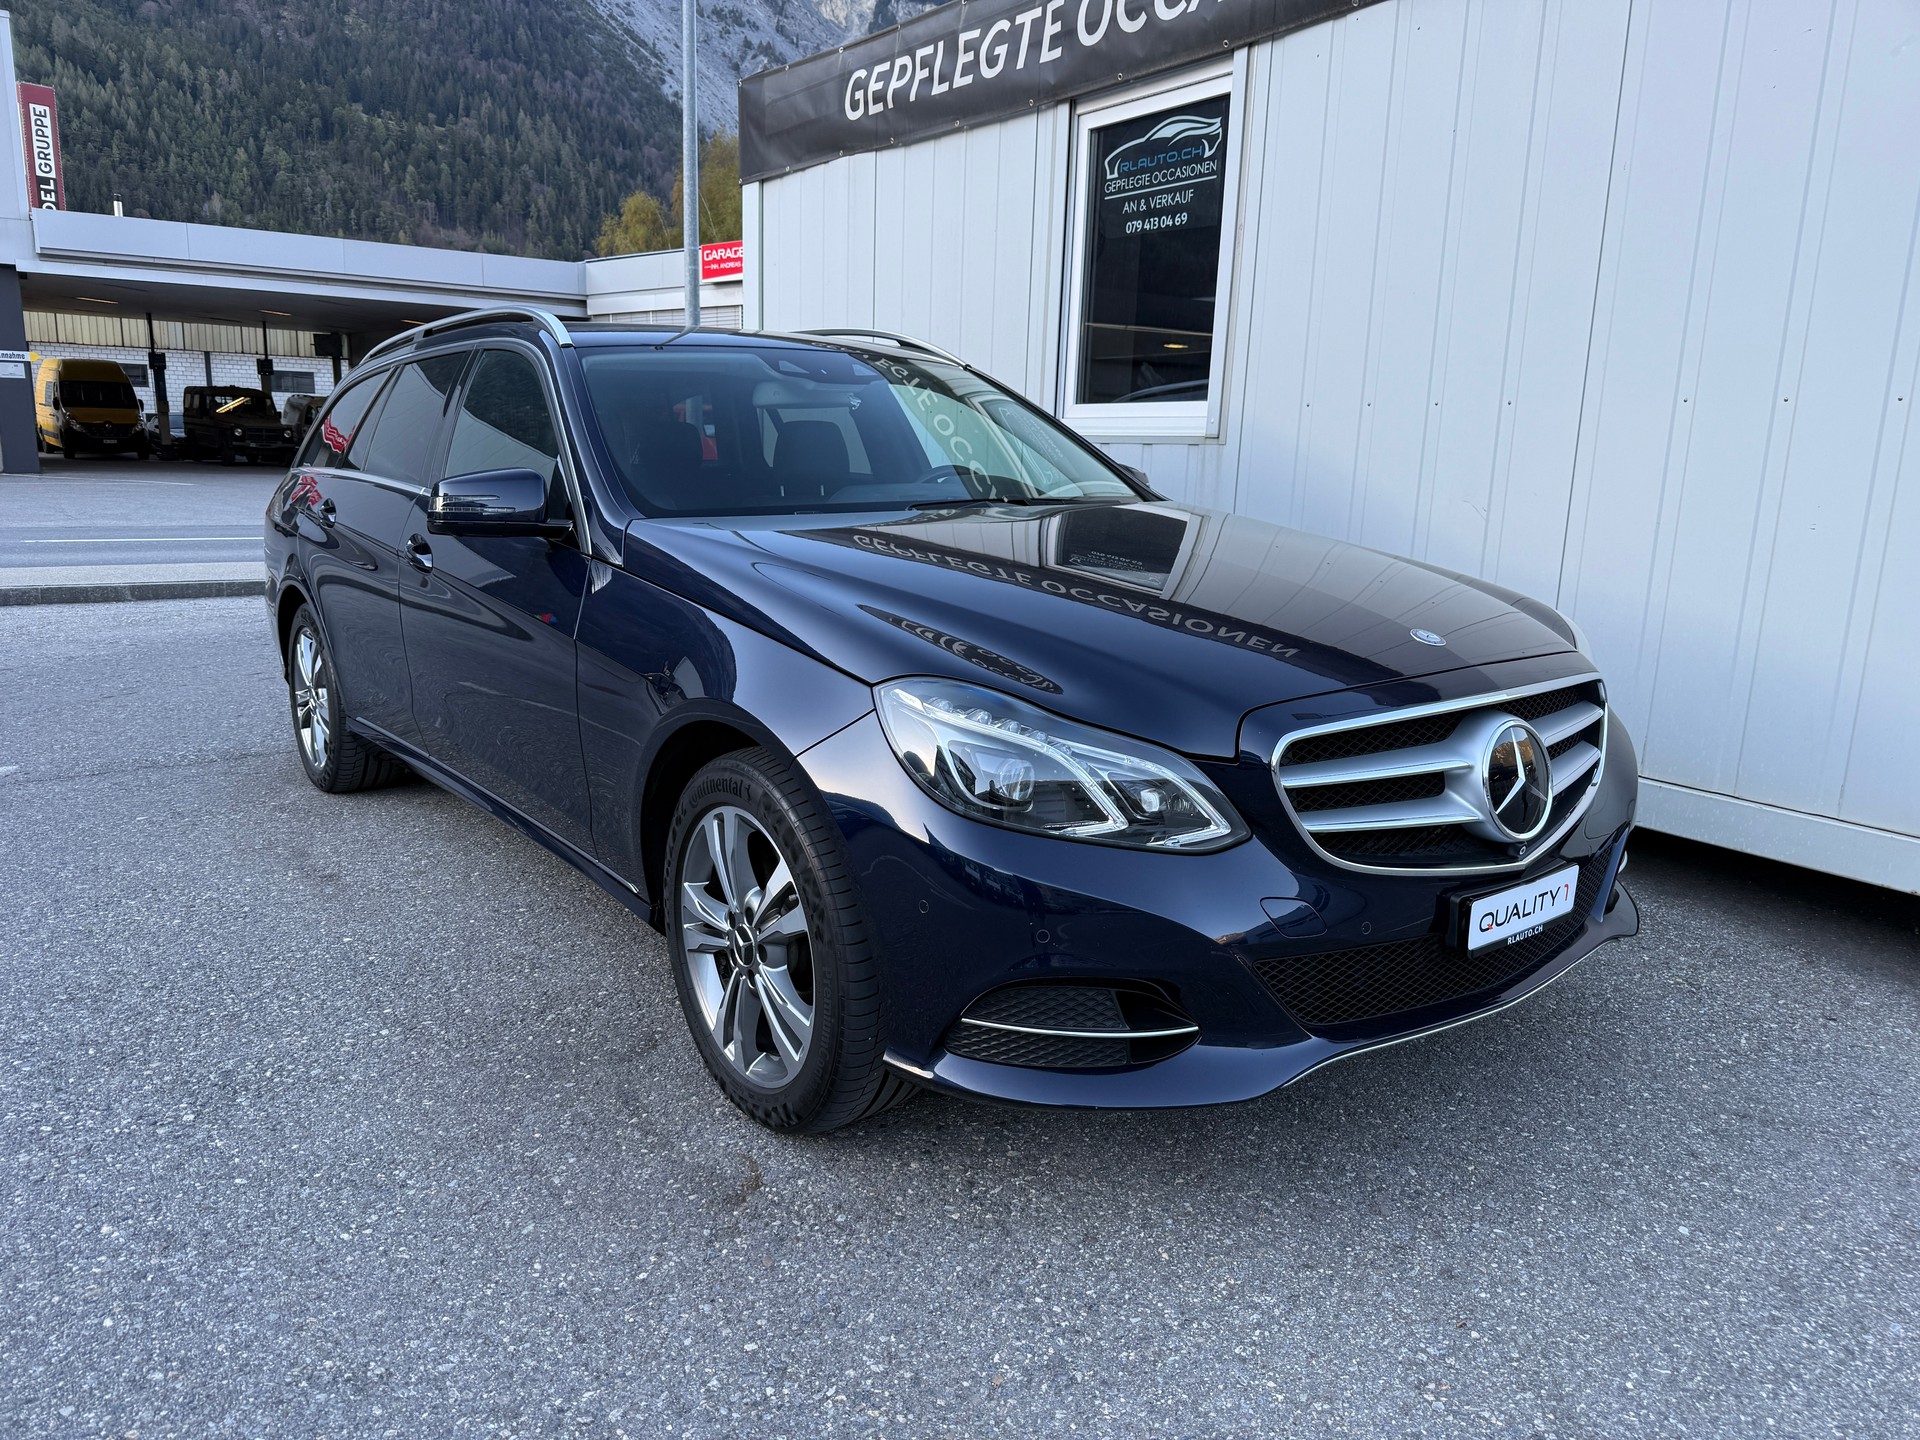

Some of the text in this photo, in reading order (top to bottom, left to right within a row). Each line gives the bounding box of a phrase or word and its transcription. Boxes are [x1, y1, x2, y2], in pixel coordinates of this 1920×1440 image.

[844, 0, 1065, 121] GEPFLEGTE
[33, 107, 53, 174] GRUPPE
[1120, 145, 1202, 173] RLAUTO.CH
[1104, 160, 1217, 194] GEPFLEGTE OCCASIONEN
[1122, 189, 1194, 214] AN & VERKAUF
[1125, 212, 1188, 234] 079 413 04 69
[0, 352, 26, 360] nnahme
[1478, 886, 1561, 933] QUALITY
[1507, 925, 1543, 945] RLAUTO.CH
